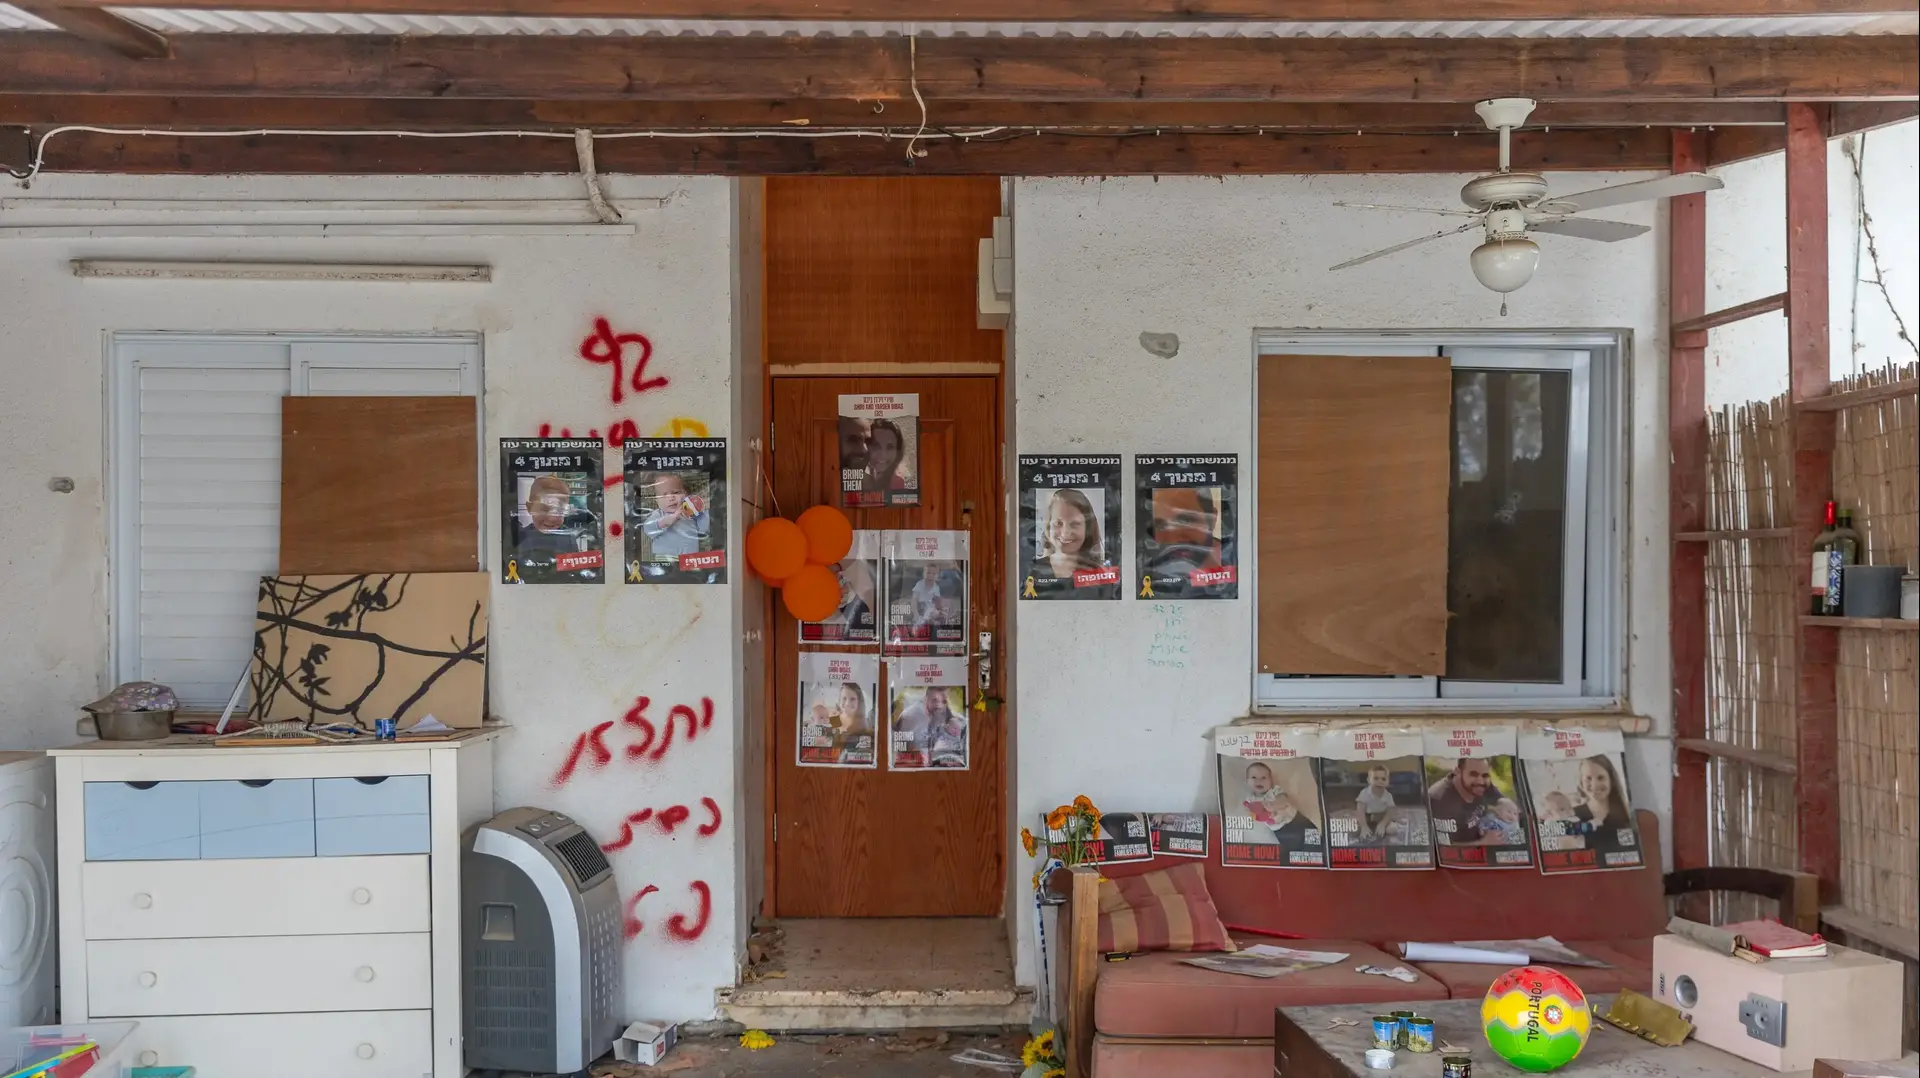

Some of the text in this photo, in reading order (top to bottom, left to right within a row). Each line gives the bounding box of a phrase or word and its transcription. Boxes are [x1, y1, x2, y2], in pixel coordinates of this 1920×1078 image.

[515, 456, 582, 469] 1 מתוך 4
[638, 456, 704, 469] 1 מתוך 4
[1137, 457, 1236, 465] ממשפחת ניר עוז
[843, 469, 864, 479] BRING
[1033, 473, 1099, 486] 1 מתוך 4
[1151, 472, 1217, 485] 1 מתוך 4
[843, 481, 862, 491] THEM
[1078, 570, 1116, 582] חטופה!
[803, 726, 822, 736] BRING
[894, 732, 914, 741] BRING
[894, 742, 907, 751] HIM
[1226, 816, 1253, 829] BRING
[1330, 818, 1358, 832] BRING
[1539, 821, 1565, 836] BRING
[1226, 829, 1244, 843] HIM
[1331, 833, 1348, 846] HIM
[1541, 837, 1560, 851] HER
[1227, 846, 1280, 859] HOME NOW!
[1332, 849, 1357, 861] HOME
[1527, 981, 1542, 1042] PORTUGAL
